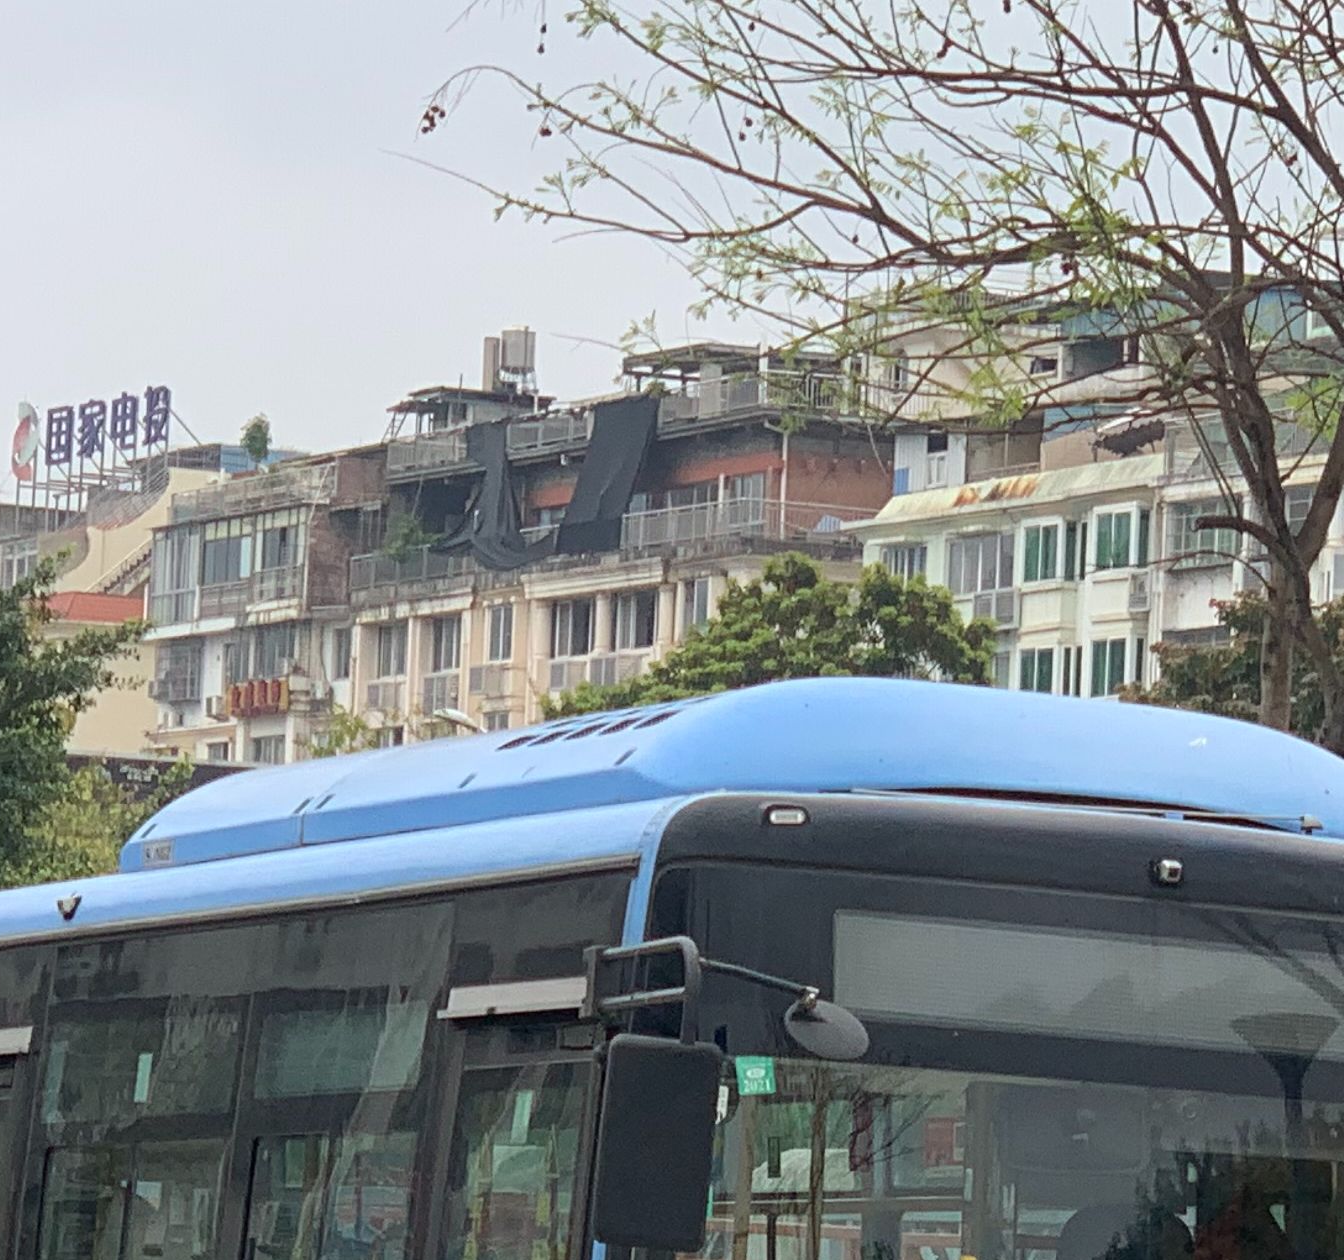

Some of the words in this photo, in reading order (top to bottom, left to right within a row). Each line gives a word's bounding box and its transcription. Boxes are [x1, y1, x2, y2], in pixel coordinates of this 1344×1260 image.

[45, 385, 172, 466] 国家电投
[743, 1079, 771, 1093] 2021
